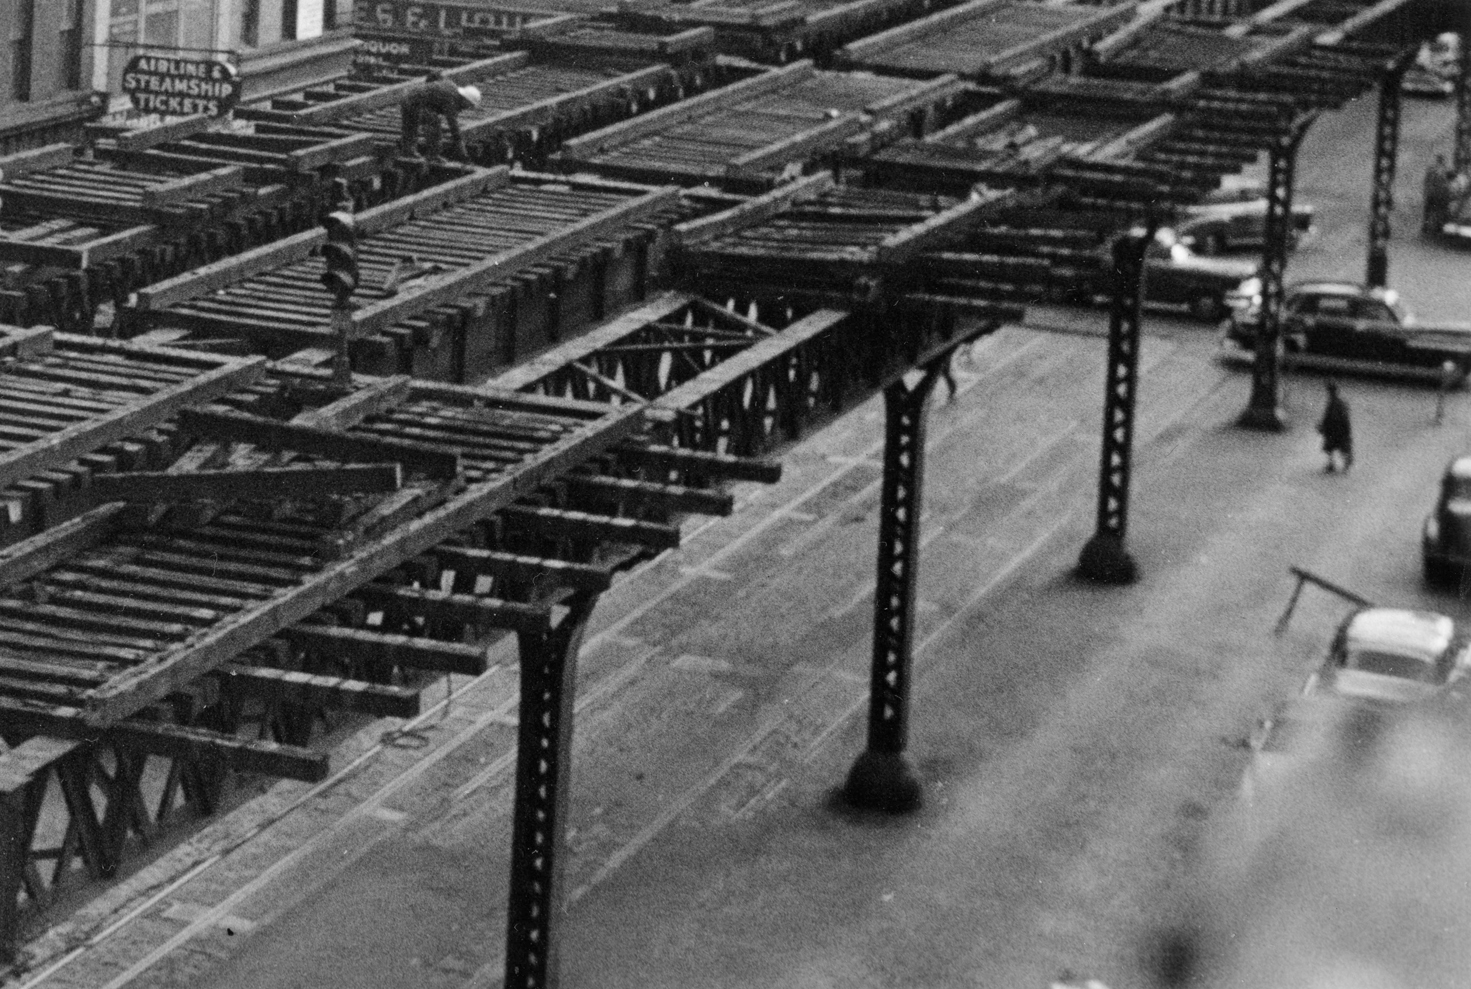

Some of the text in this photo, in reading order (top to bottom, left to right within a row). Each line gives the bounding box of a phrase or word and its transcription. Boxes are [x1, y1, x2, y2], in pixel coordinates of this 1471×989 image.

[138, 57, 222, 79] AIRLINE &
[124, 73, 233, 98] STEAMSHIP
[134, 93, 218, 116] TICKETS
